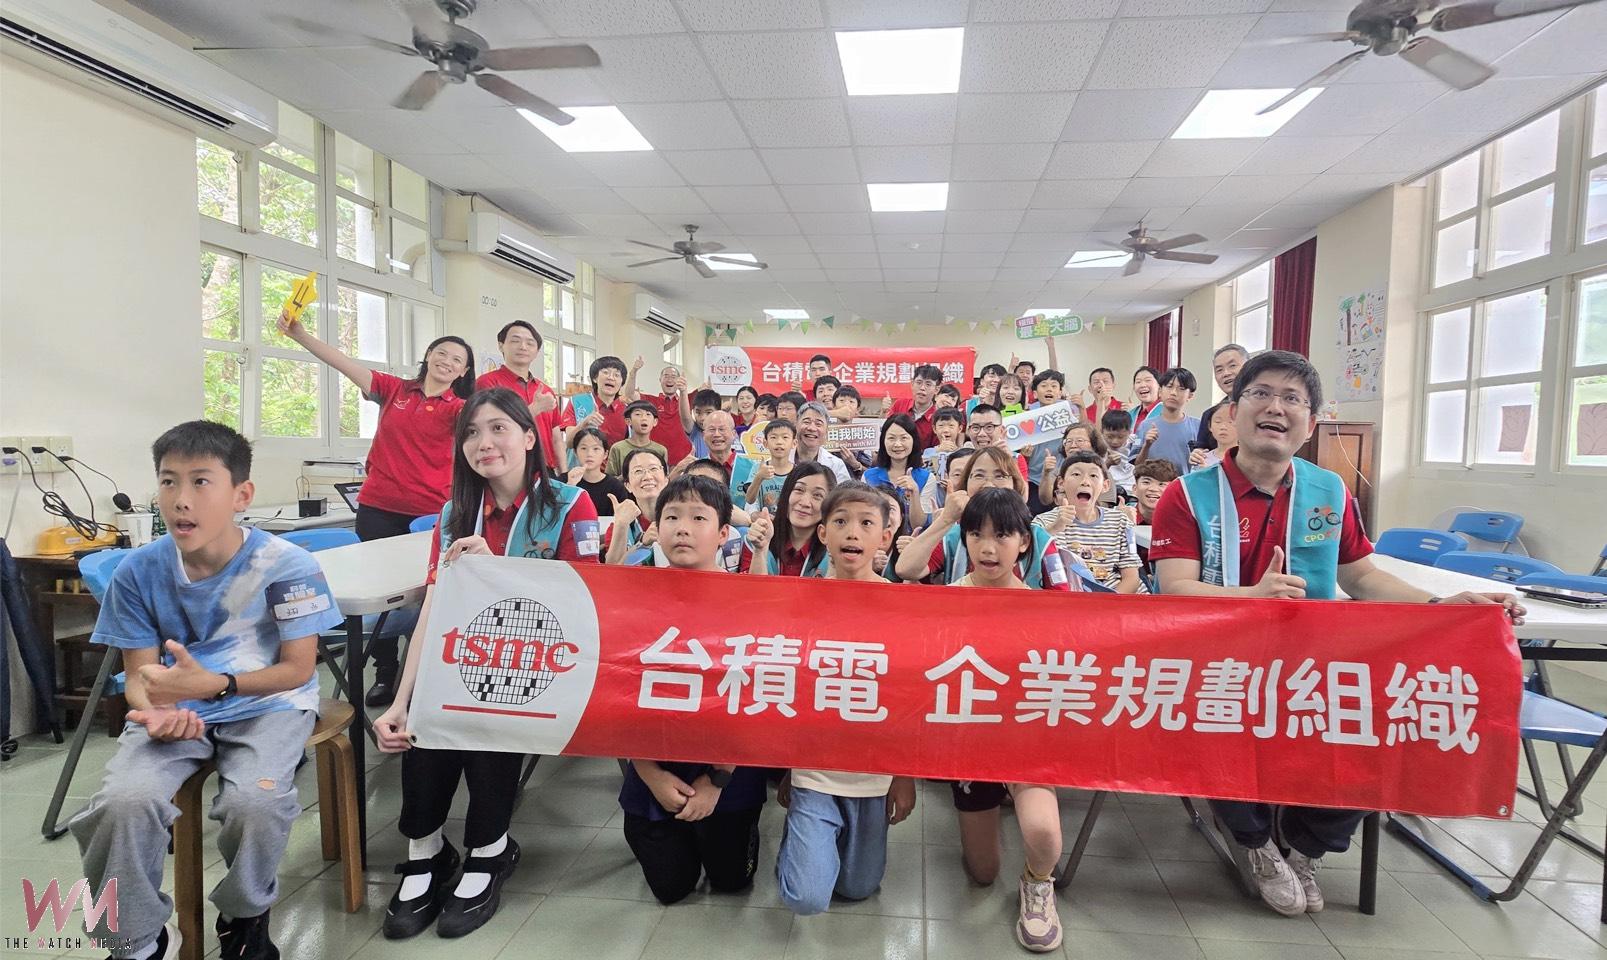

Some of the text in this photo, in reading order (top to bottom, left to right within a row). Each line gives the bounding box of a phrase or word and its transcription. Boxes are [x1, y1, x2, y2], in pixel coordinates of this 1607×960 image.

[710, 364, 747, 375] tsmc
[762, 361, 964, 384] 台積 企業規劃織
[1038, 408, 1073, 432] 公益
[827, 427, 876, 441] 由我開始
[441, 626, 580, 674] tsmc
[638, 625, 1480, 755] 台積電 企業規劃組織
